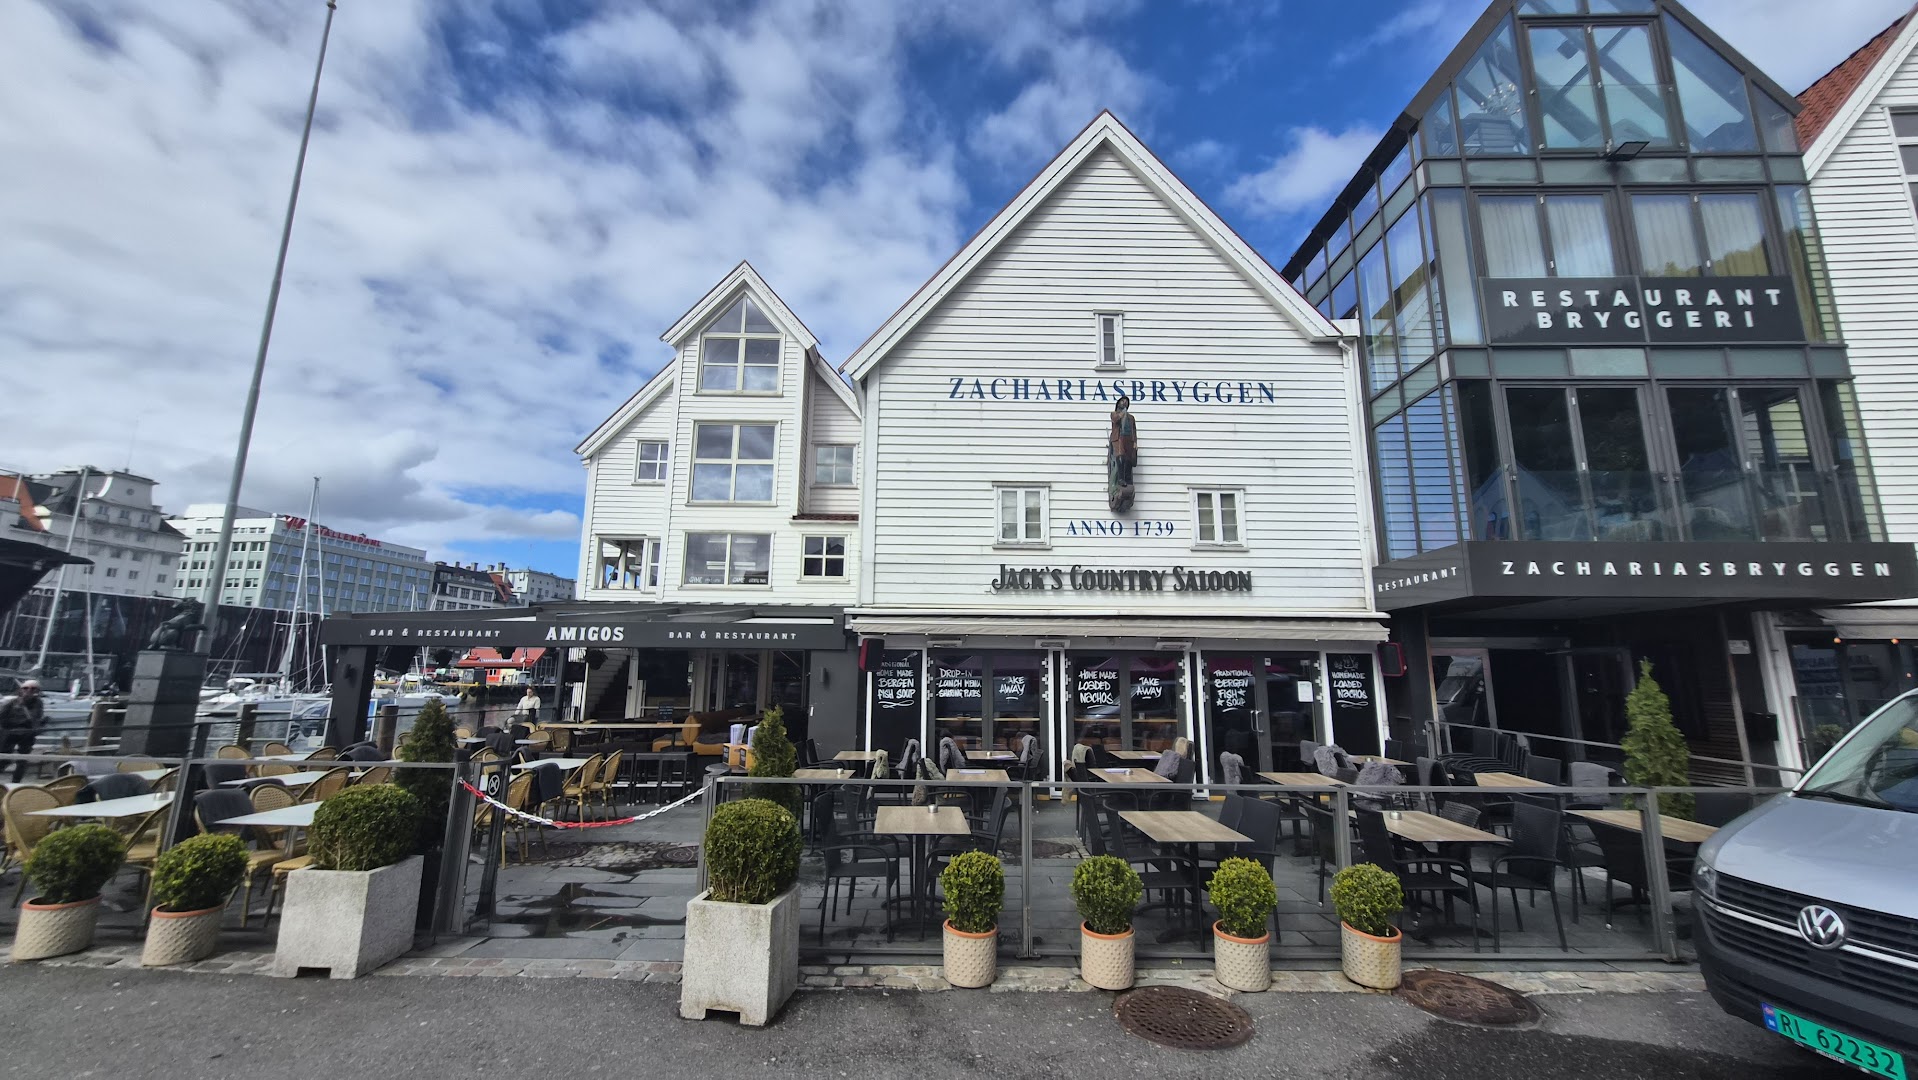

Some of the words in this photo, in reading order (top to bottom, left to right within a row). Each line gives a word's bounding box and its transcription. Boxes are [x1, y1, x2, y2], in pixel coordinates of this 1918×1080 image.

[1502, 288, 1780, 307] RESTAURANT
[1537, 310, 1754, 329] BRYGGERI
[948, 377, 1275, 404] ZACHARIASBRYGGEN
[1066, 520, 1124, 536] ANNO
[1133, 521, 1175, 537] 1739
[1502, 561, 1890, 577] ZACHARIASBRYGGEN
[991, 564, 1063, 592] JACK'S
[1069, 564, 1166, 592] COUNTRY
[1172, 565, 1252, 592] SALOON
[1378, 566, 1457, 592] RESTAURANT
[370, 628, 394, 637] BAR
[402, 627, 409, 637] &
[417, 629, 500, 638] RESTAURANT
[545, 626, 625, 642] AMIGOS
[668, 631, 692, 640] BAR
[700, 630, 707, 640] &
[715, 631, 797, 640] RESTAURANT
[896, 669, 914, 677] MADE
[1078, 669, 1098, 680] HOME
[1099, 671, 1118, 680] MADE
[1213, 669, 1253, 677] TRADITIONAL
[878, 677, 915, 688] BERGEN
[1138, 676, 1160, 686] TAKE
[1213, 678, 1249, 688] BERGEN
[1333, 680, 1363, 689] LOADED
[877, 688, 895, 699] FISH
[895, 688, 917, 699] SOUP
[998, 683, 1026, 696] AWAY
[1135, 686, 1163, 699] AWAY
[1217, 688, 1238, 699] FISH
[1226, 697, 1246, 707] SOUP
[1780, 1014, 1807, 1041] RL
[1816, 1029, 1898, 1076] 62232
